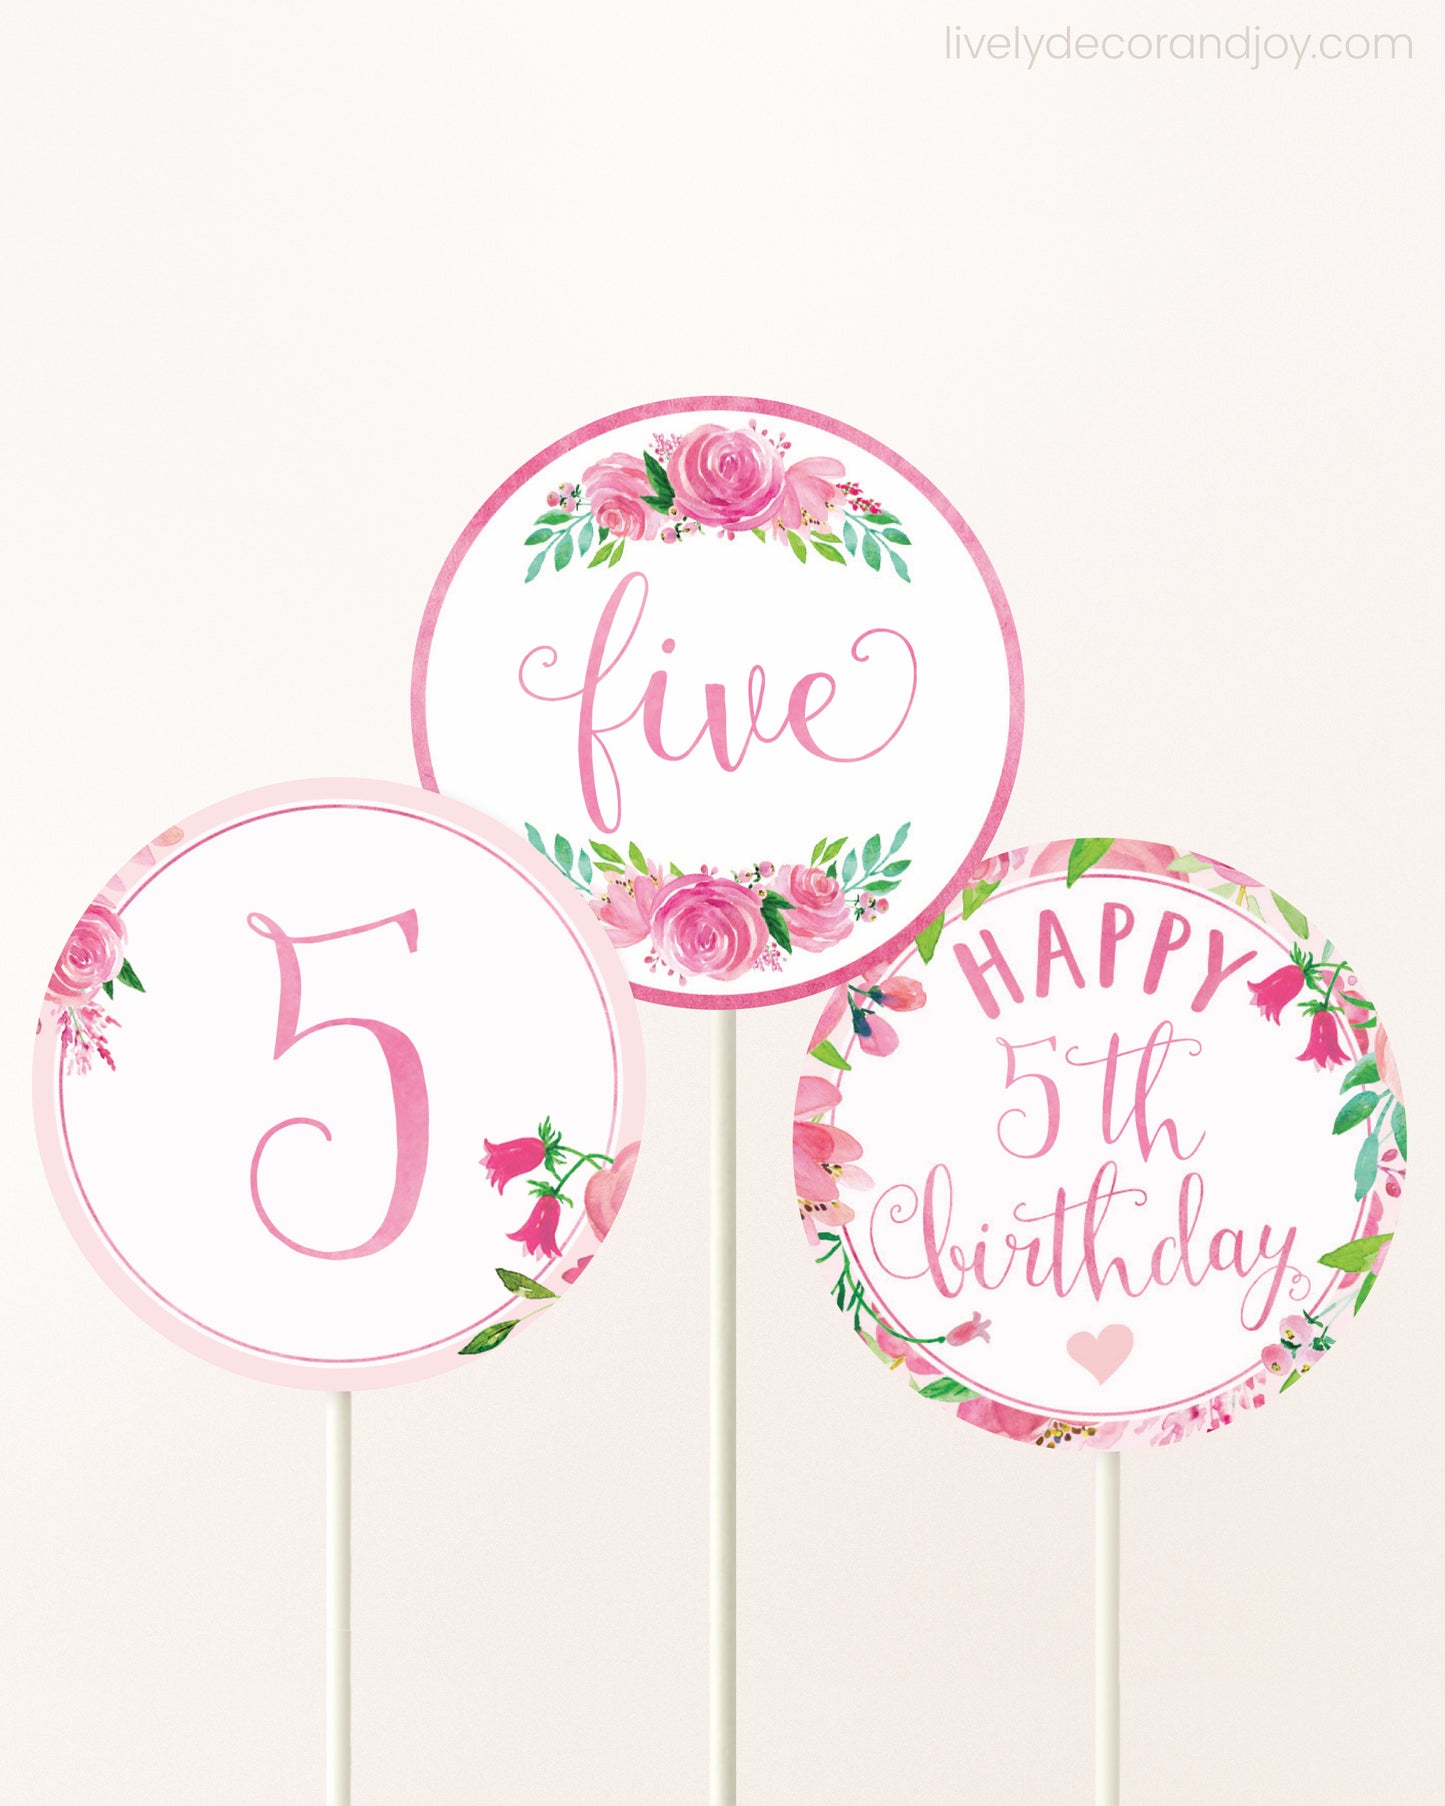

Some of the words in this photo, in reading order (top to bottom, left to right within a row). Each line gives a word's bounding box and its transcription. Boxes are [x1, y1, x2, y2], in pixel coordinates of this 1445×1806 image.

[519, 572, 918, 834] five
[953, 901, 1257, 1020] HAPPY
[247, 909, 429, 1260] 5
[870, 1160, 1313, 1331] birthday
